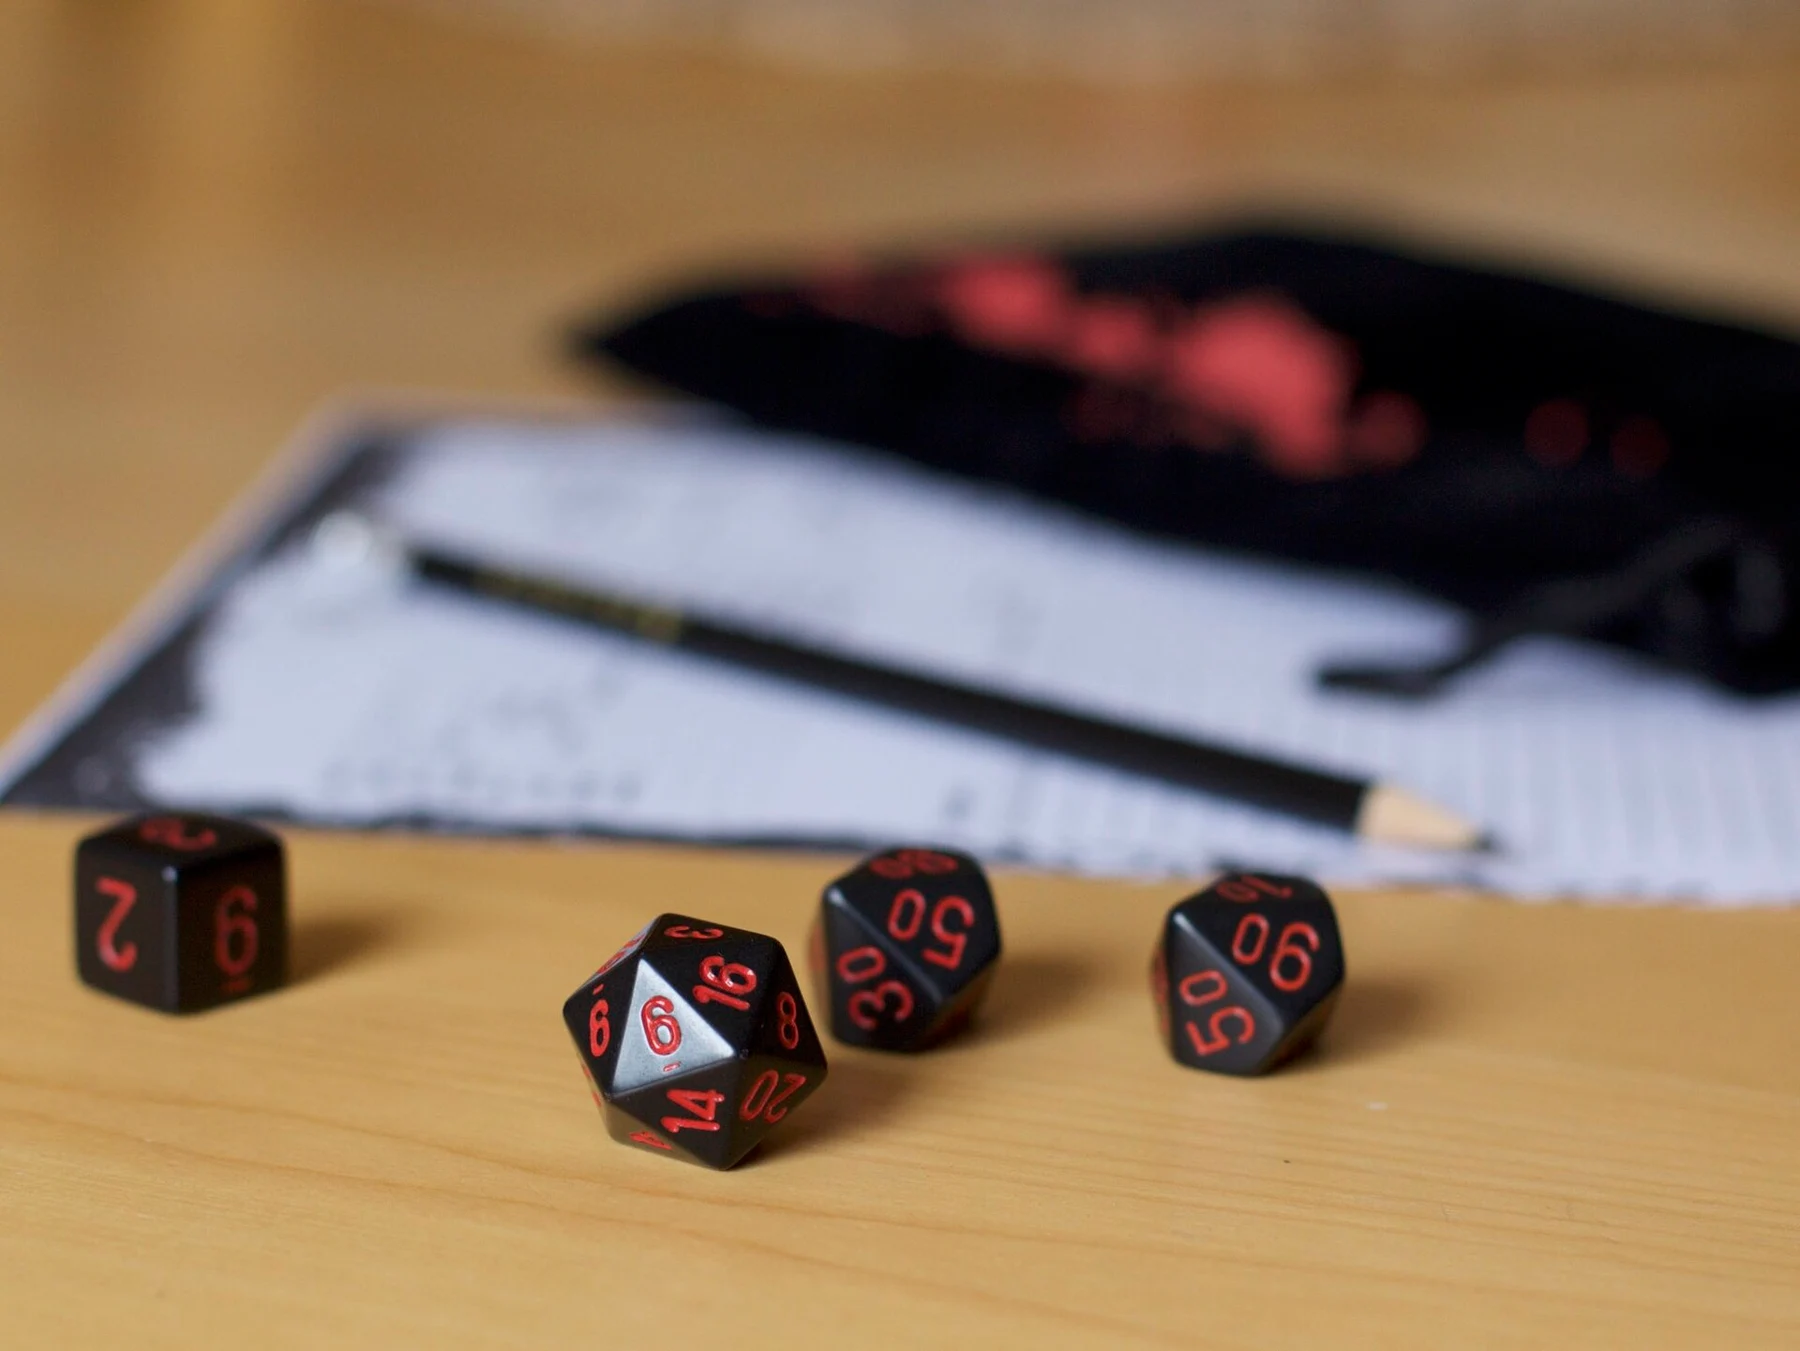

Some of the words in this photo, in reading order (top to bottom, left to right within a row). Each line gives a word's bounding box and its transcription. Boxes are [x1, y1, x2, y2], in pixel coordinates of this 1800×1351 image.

[692, 955, 758, 1011] 16
[641, 995, 682, 1056] 6
[776, 992, 800, 1050] 8
[661, 1088, 725, 1133] 14
